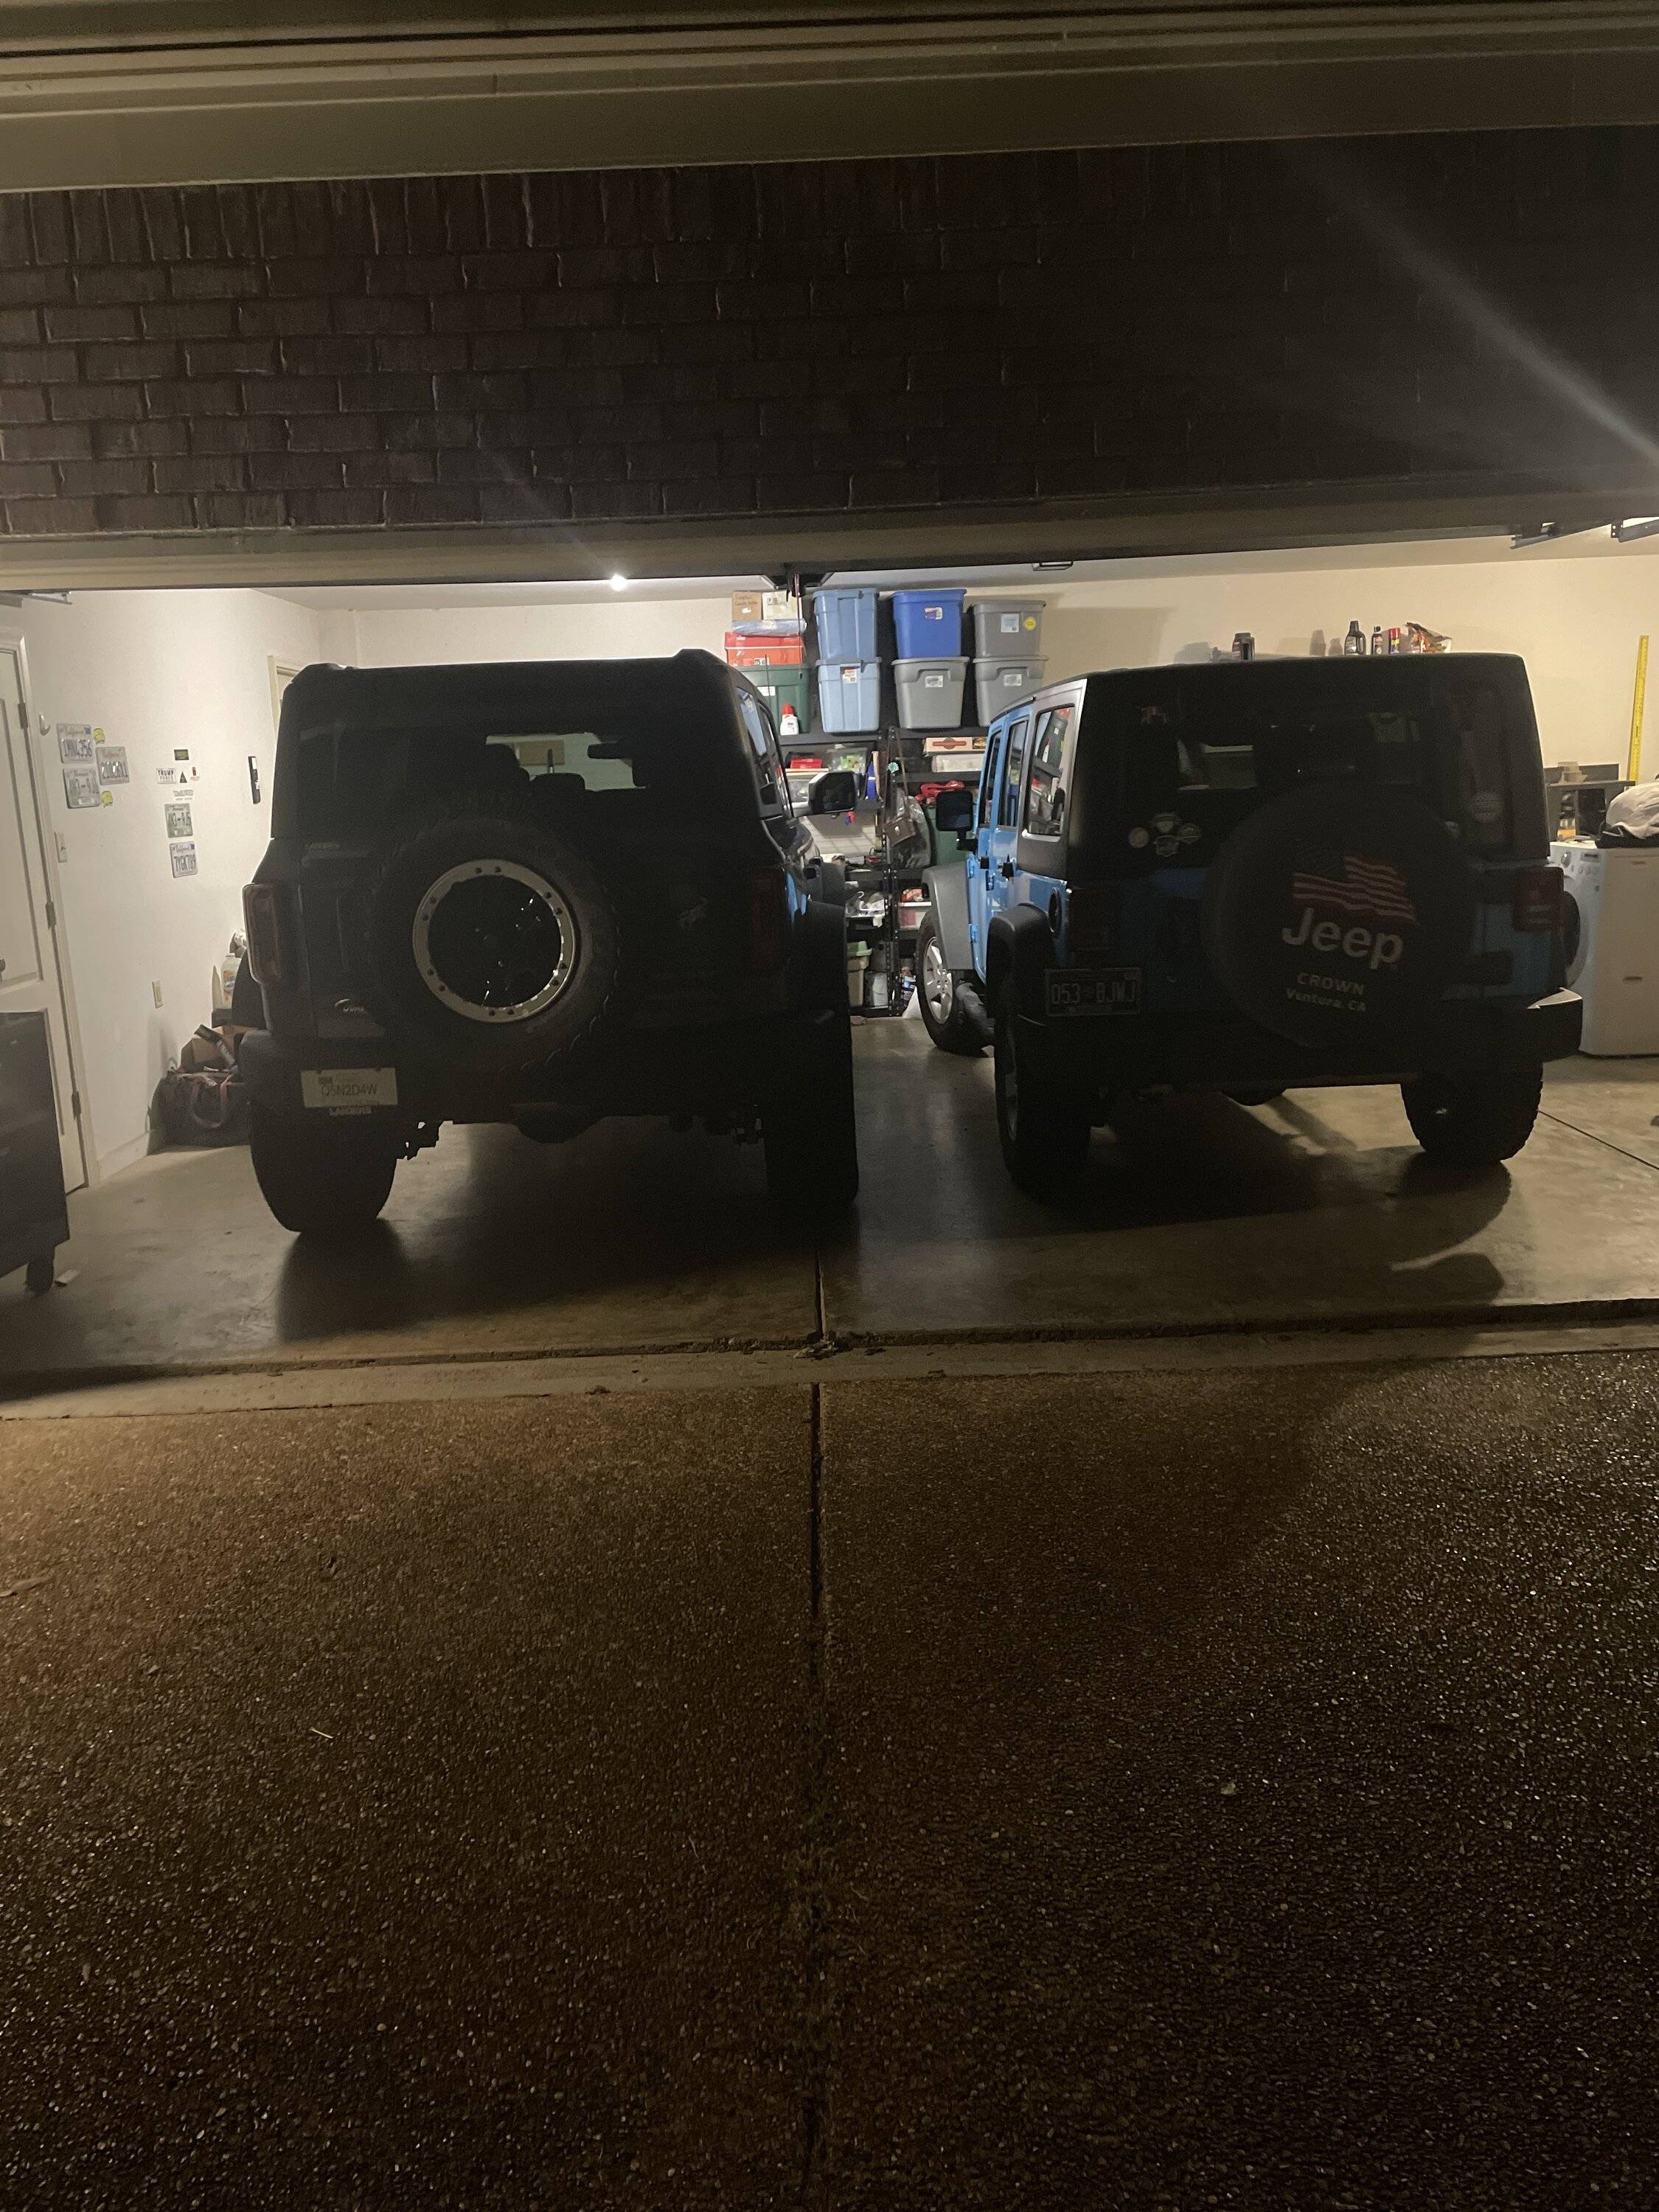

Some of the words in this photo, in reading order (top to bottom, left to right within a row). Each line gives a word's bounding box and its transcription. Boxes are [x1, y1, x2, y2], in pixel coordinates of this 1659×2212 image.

[1281, 907, 1404, 970] Jeep
[1297, 972, 1366, 995] CROWN
[1348, 1000, 1366, 1012] CA
